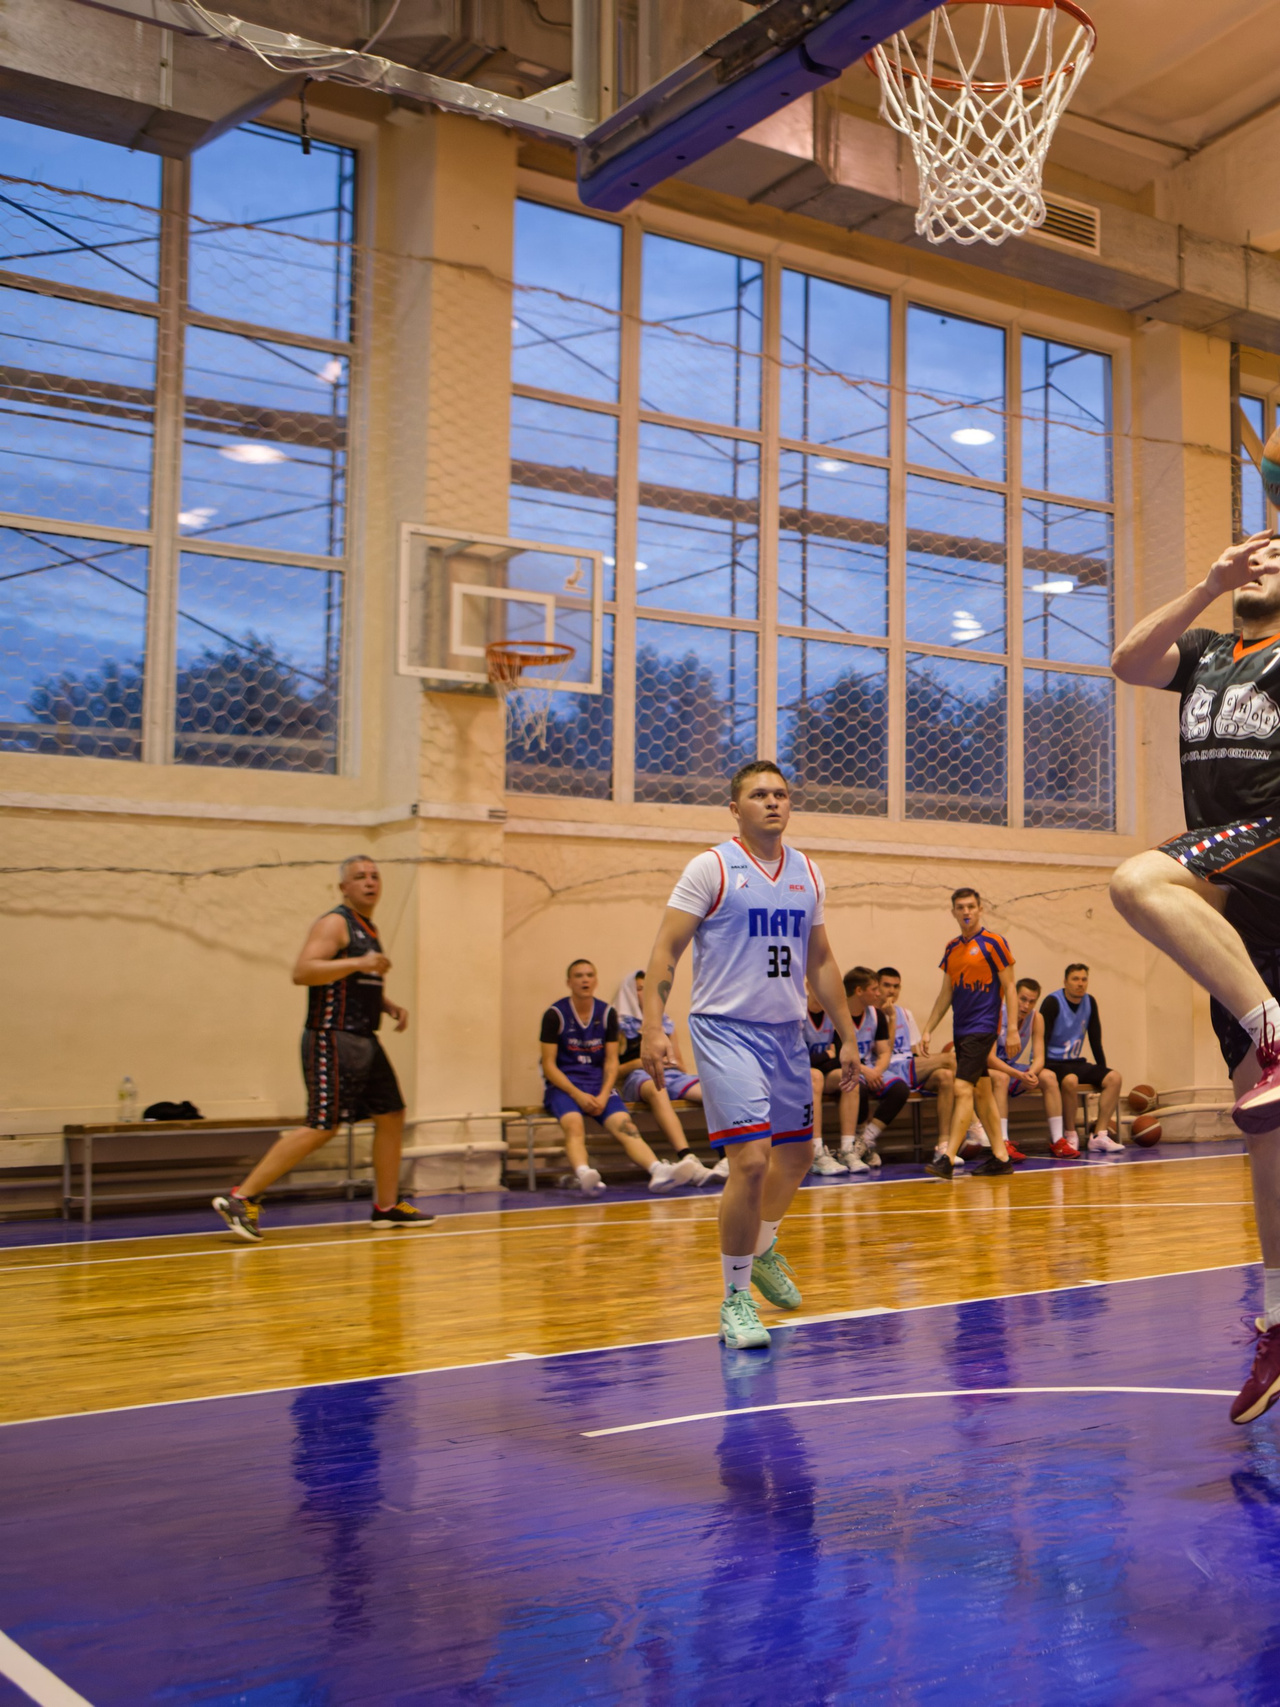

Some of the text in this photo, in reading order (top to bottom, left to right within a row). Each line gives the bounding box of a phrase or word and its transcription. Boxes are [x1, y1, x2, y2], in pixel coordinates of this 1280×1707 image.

[1227, 747, 1272, 761] COMPANY
[748, 908, 806, 938] ПАТ
[767, 945, 792, 978] 33
[1062, 1039, 1082, 1060] 10
